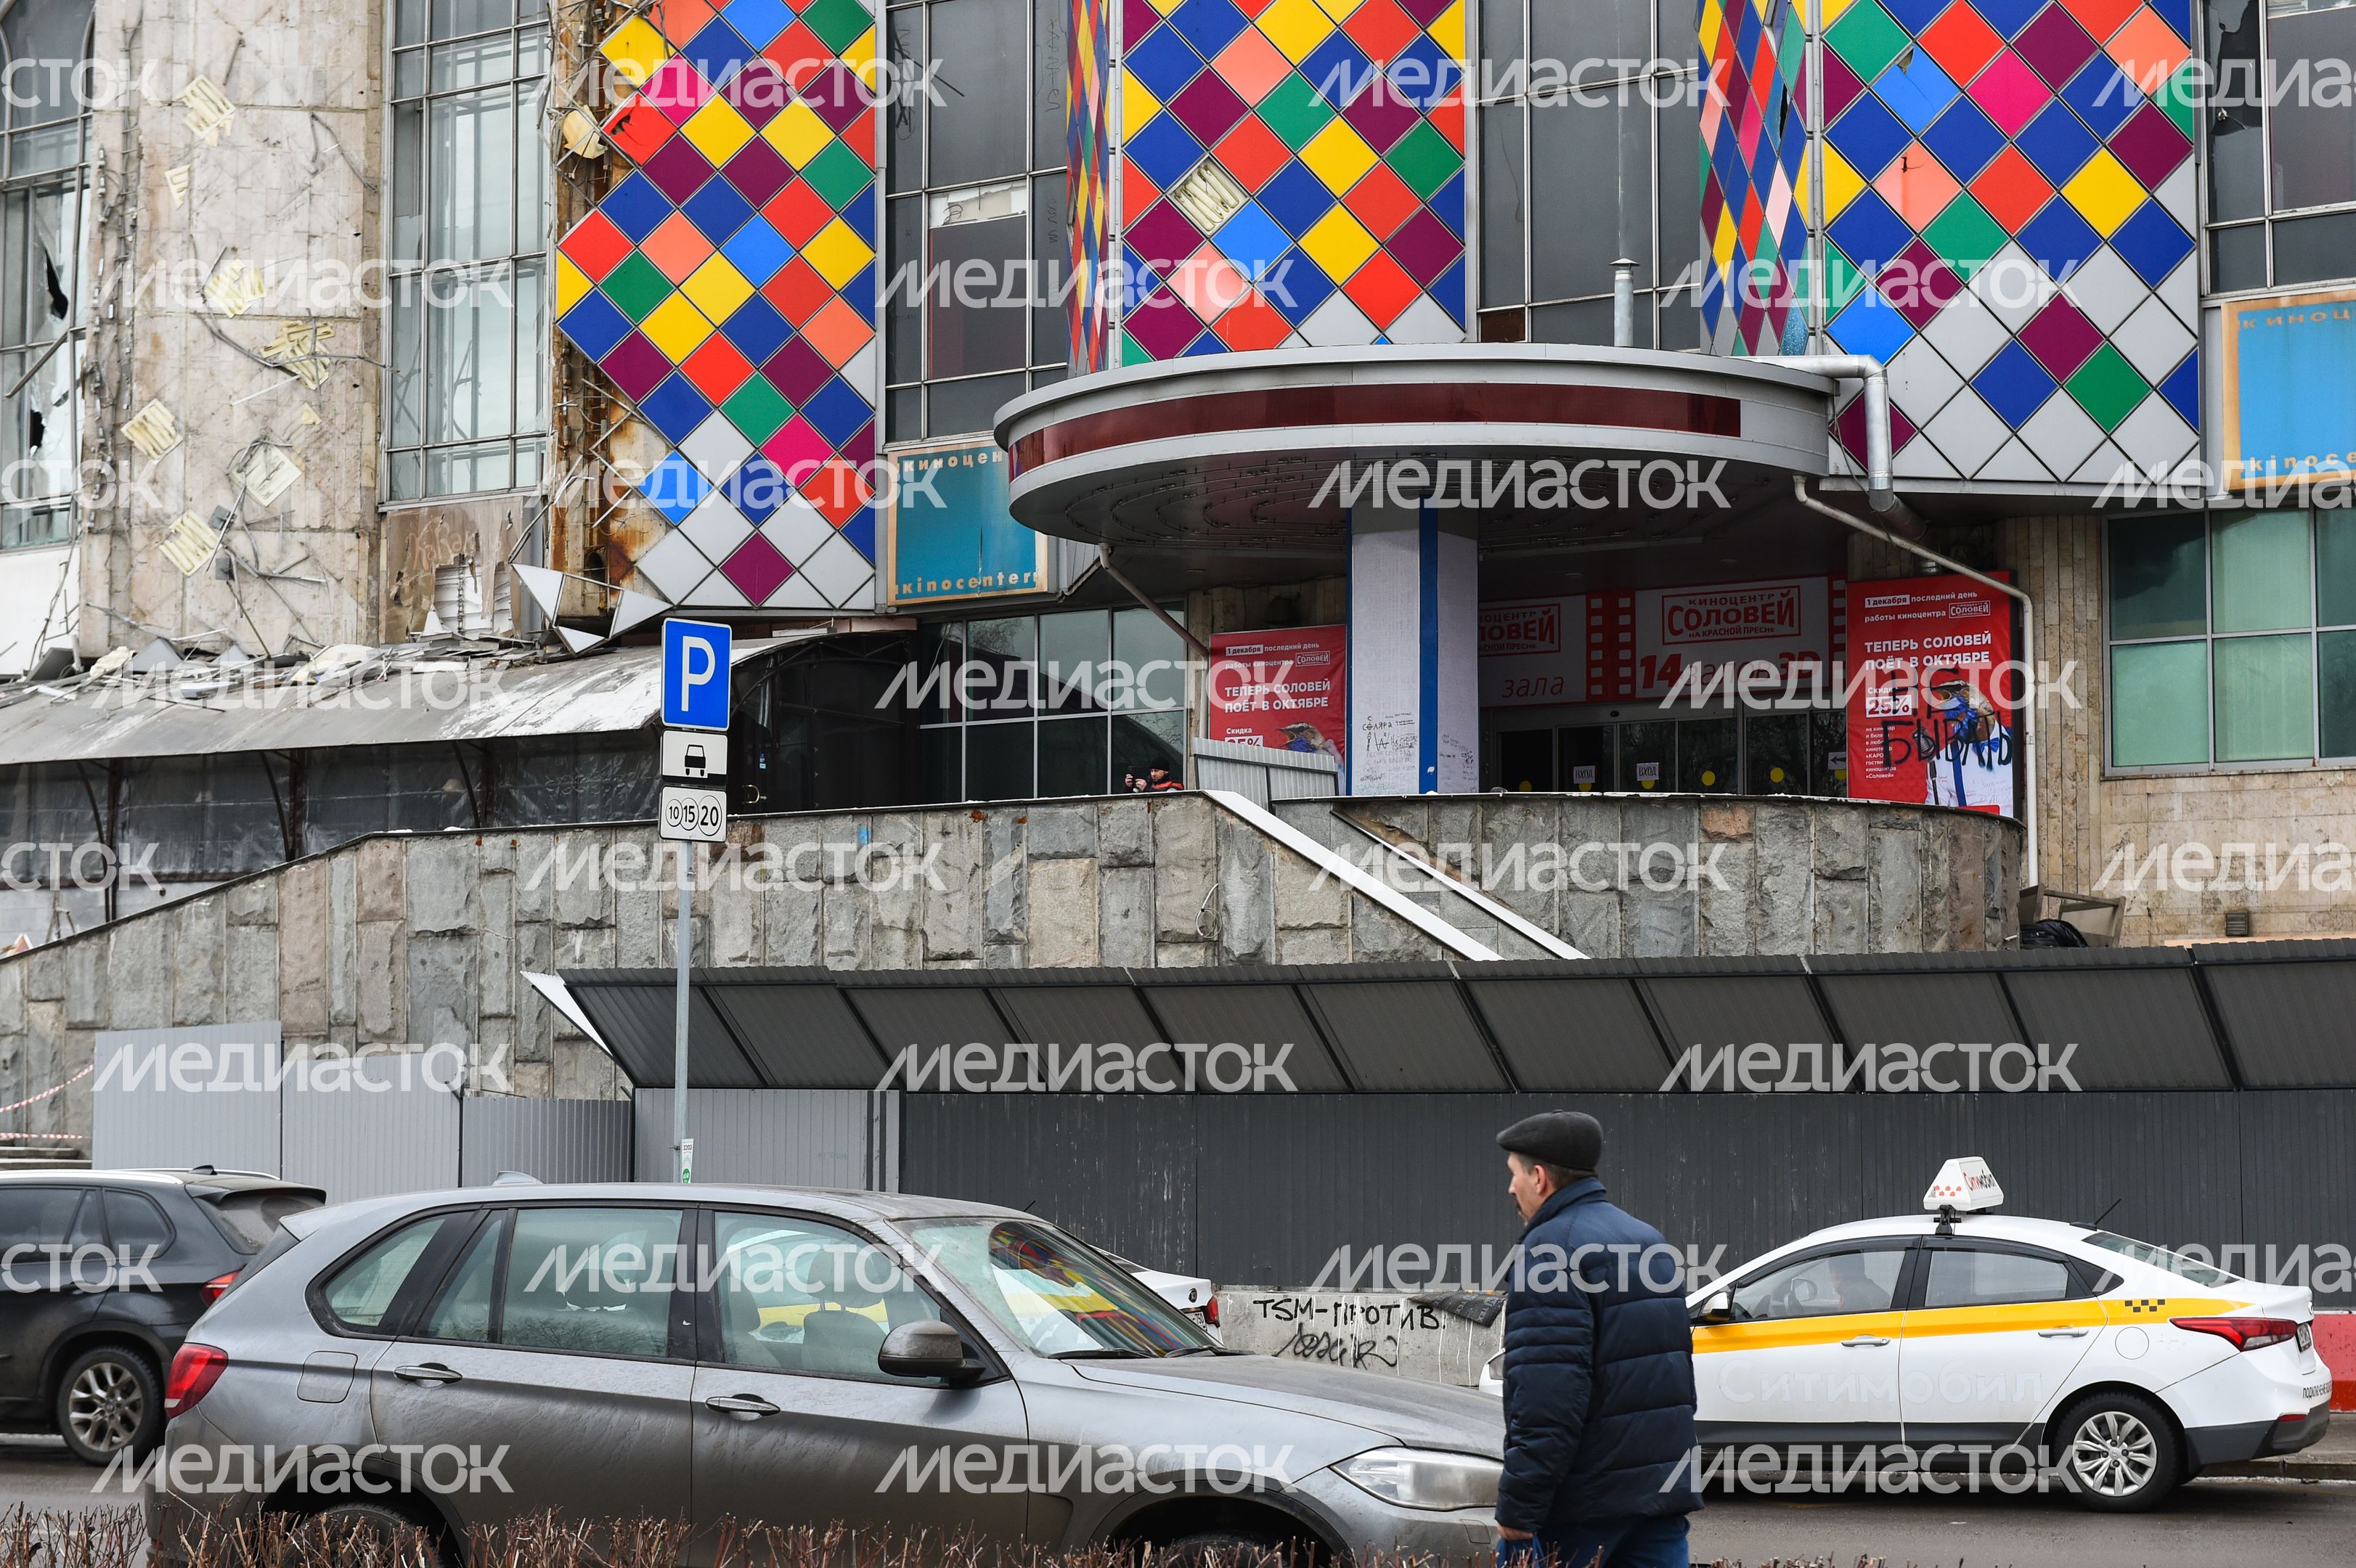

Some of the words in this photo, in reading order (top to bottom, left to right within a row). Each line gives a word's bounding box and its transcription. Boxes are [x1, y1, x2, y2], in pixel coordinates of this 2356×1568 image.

[2243, 309, 2355, 328] киноц
[1689, 593, 1775, 606] КИНОЦЕНТР
[1872, 597, 1907, 606] декабря
[1912, 592, 1955, 603] последний
[1668, 589, 1794, 636] СОЛОВЕЙ
[1864, 614, 1896, 624] работы
[1898, 611, 1946, 620] киноцентра
[1951, 602, 1989, 616] СОЛОВЕЙ
[1702, 626, 1742, 637] КРАСНОЙ
[1231, 646, 1261, 655] декабря
[1864, 640, 1918, 653] ТЕПЕРЬ
[1923, 630, 1992, 648] СОЛОВЕЙ
[1865, 656, 1903, 671] ПОЁТ
[1909, 657, 1918, 667] В
[1923, 650, 1990, 666] ОКТЯБРЕ
[681, 635, 716, 712] P
[1640, 653, 1683, 690] 14
[1683, 661, 1772, 687] залов
[1774, 651, 1820, 680] 3D
[1225, 685, 1269, 698] ТЕПЕРЬ
[1273, 679, 1330, 693] СОЛОВЕЙ
[1502, 676, 1565, 698] зала
[1867, 686, 1898, 695] Скидк
[1225, 699, 1257, 713] ПОЁТ
[1262, 701, 1269, 711] В
[1273, 697, 1328, 710] ОКТЯБРЕ
[1868, 698, 1909, 715] 25%
[1576, 769, 1594, 779] ВХОД
[1639, 766, 1657, 777] ВХОД
[669, 805, 680, 820] 10
[682, 805, 696, 823] 15
[700, 805, 719, 827] 20
[1719, 1358, 2042, 1404] Ситимобил
